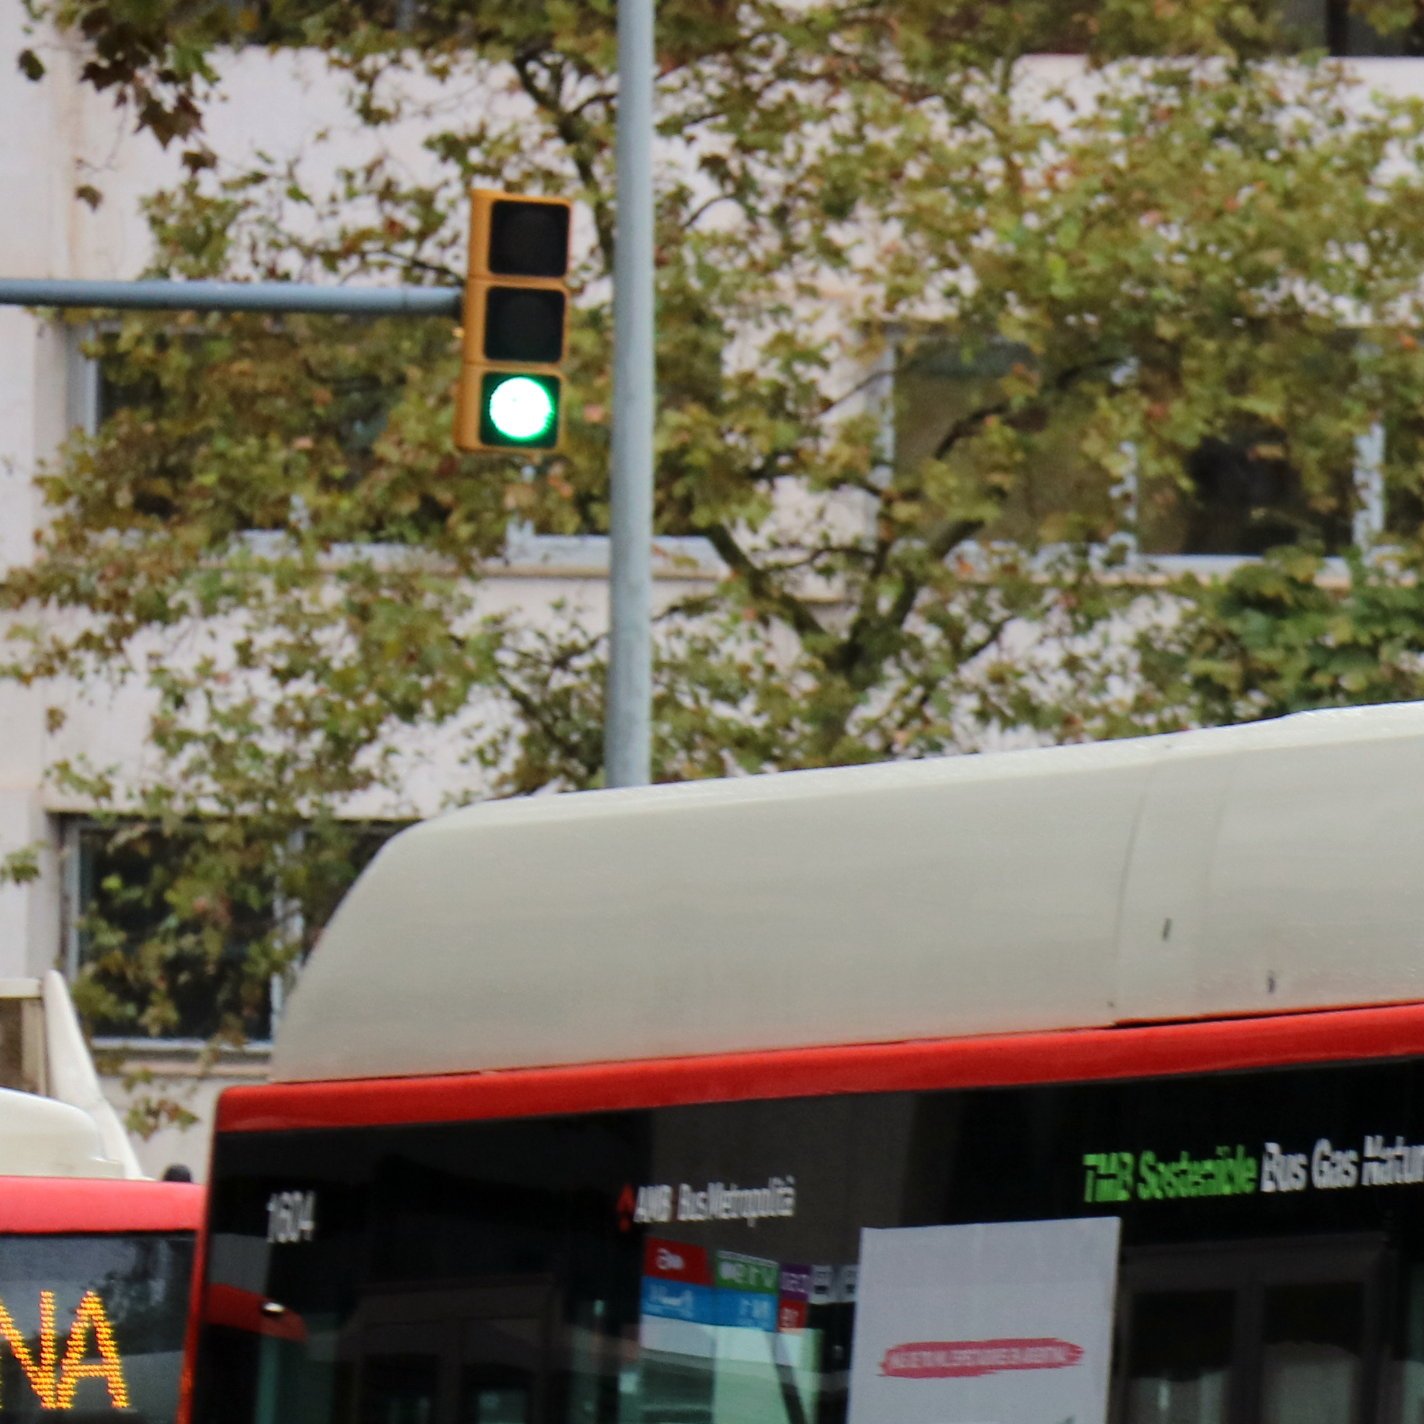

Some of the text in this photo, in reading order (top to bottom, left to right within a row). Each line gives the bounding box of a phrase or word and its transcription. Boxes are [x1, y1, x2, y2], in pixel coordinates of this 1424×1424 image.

[1083, 1152, 1133, 1202] TMB
[1260, 1142, 1308, 1192] Bus
[1312, 1138, 1358, 1189] Gas
[266, 1190, 315, 1243] 1604
